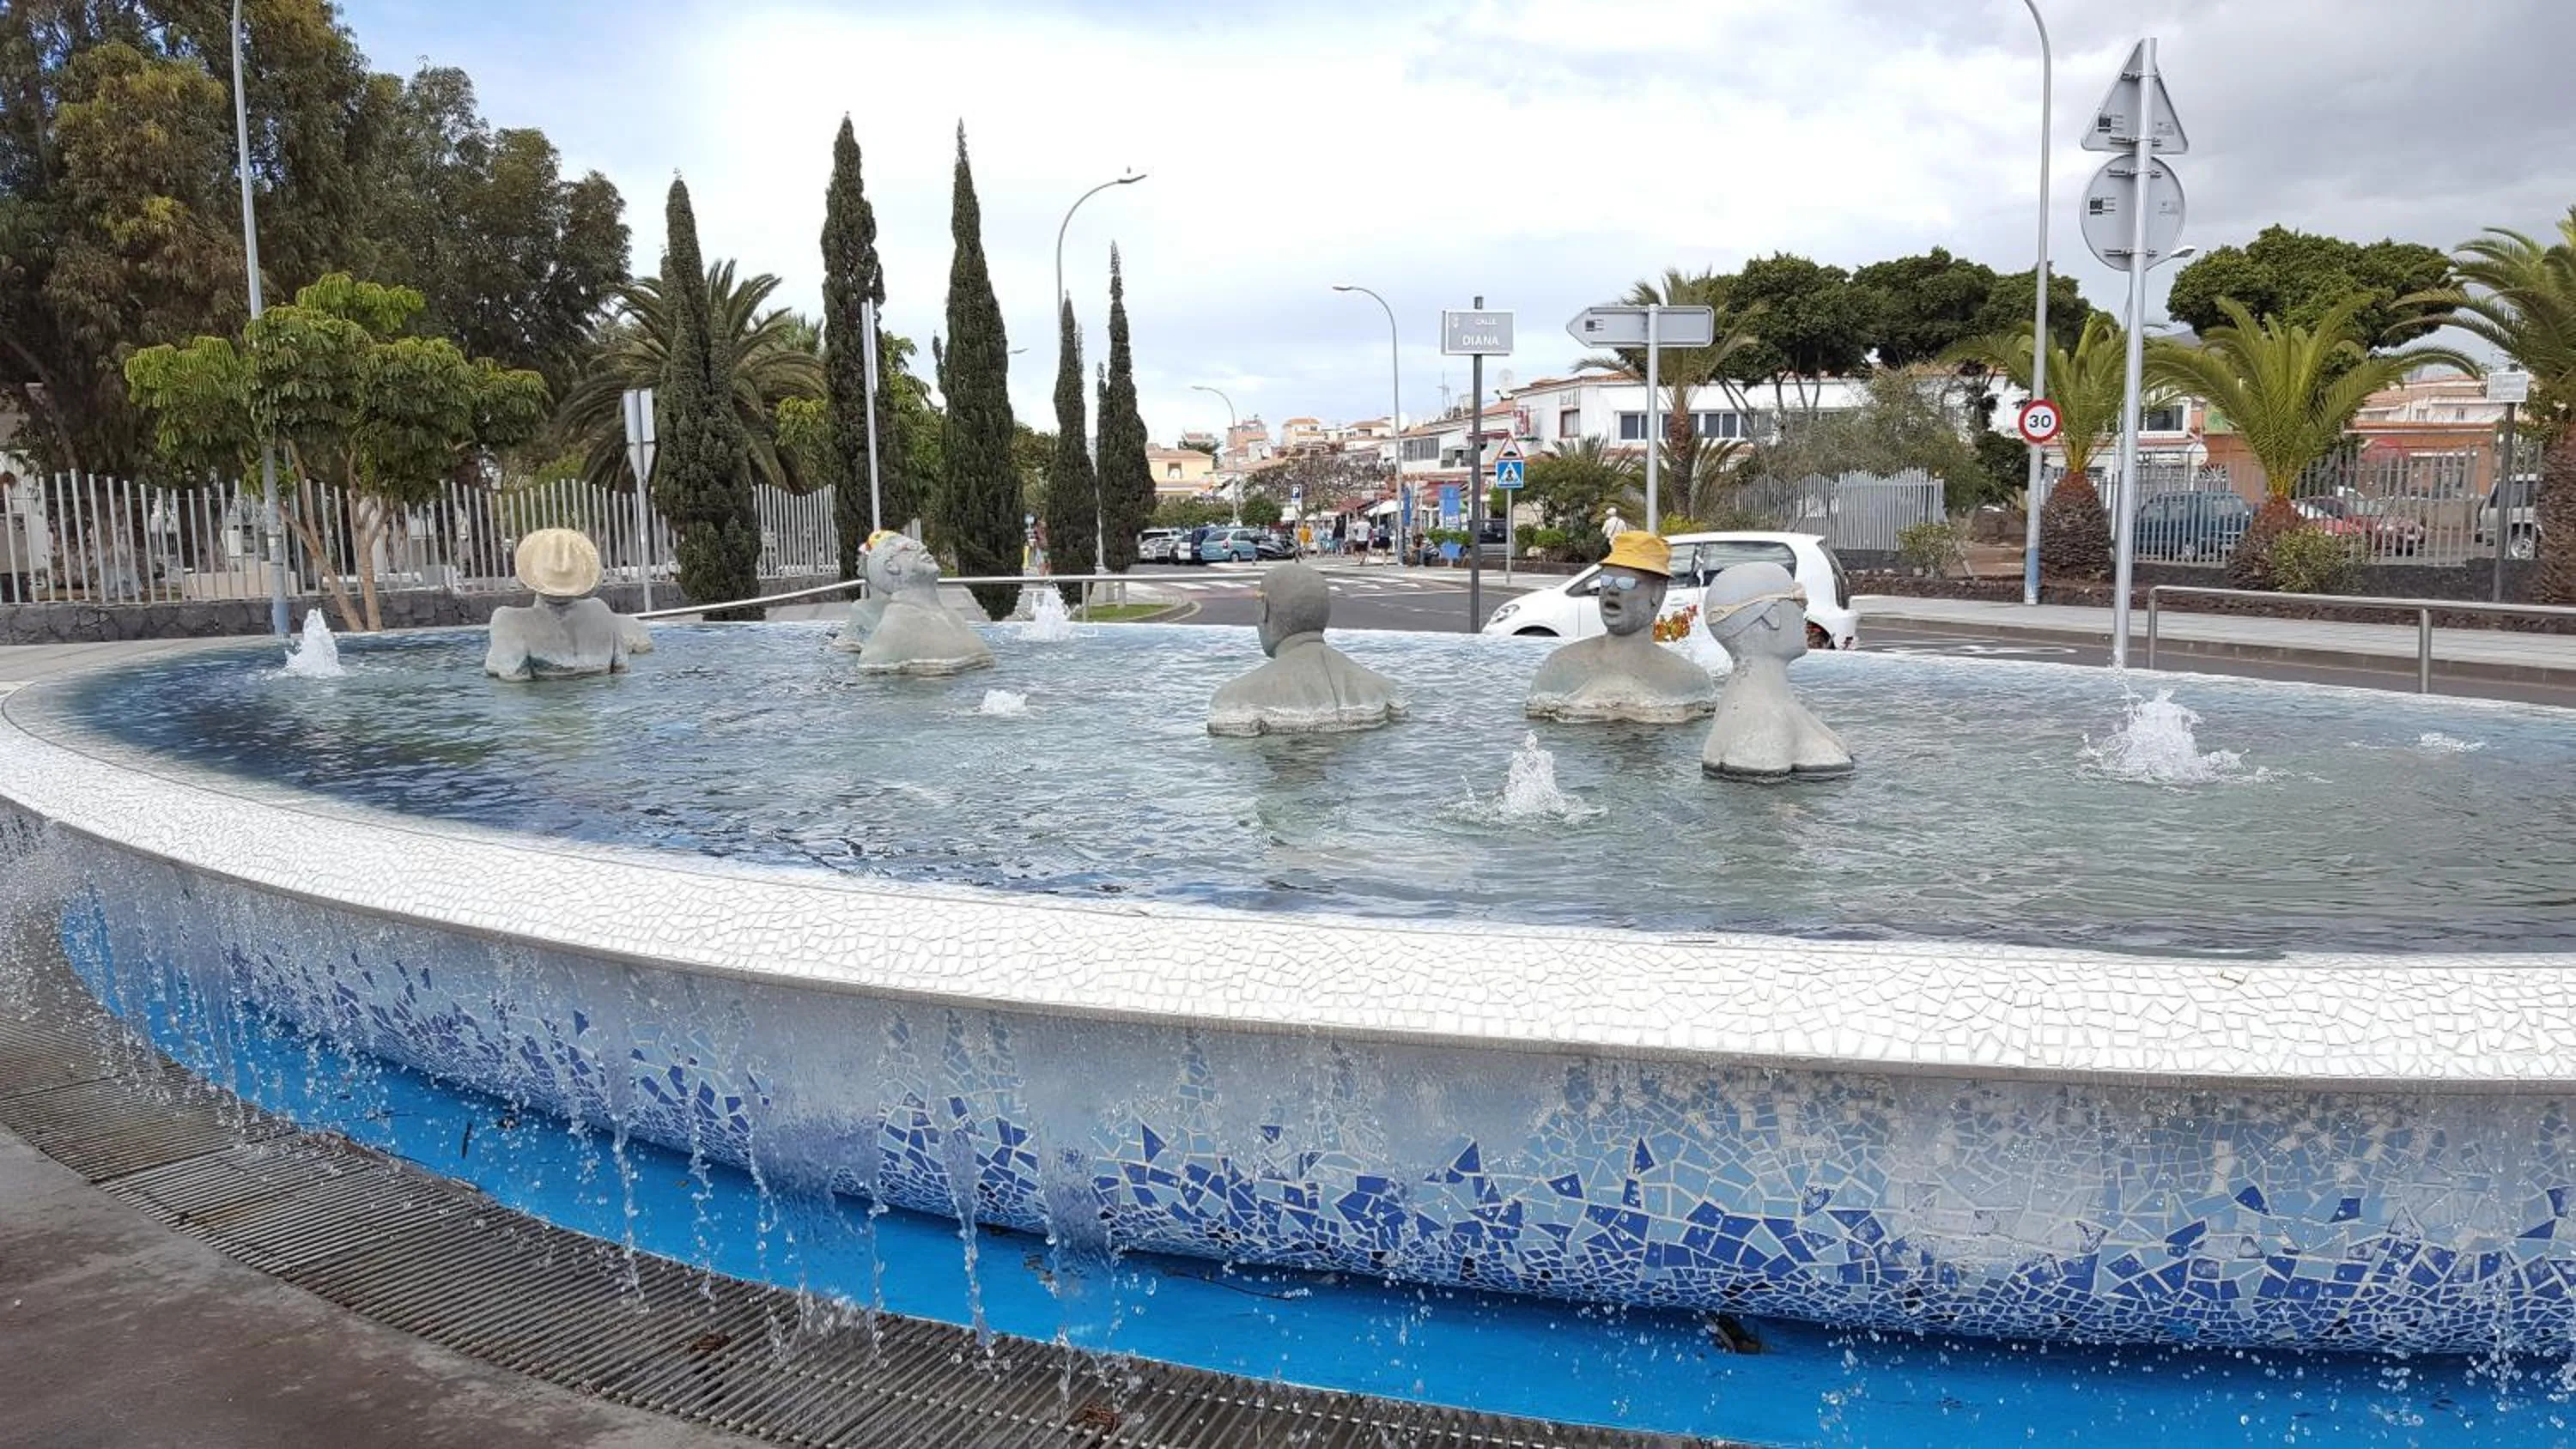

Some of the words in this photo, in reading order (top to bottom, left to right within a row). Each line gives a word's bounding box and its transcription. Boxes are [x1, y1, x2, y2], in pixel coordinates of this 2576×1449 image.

[1462, 335, 1500, 346] DIANA
[2029, 415, 2051, 428] 30
[1292, 487, 1299, 497] P
